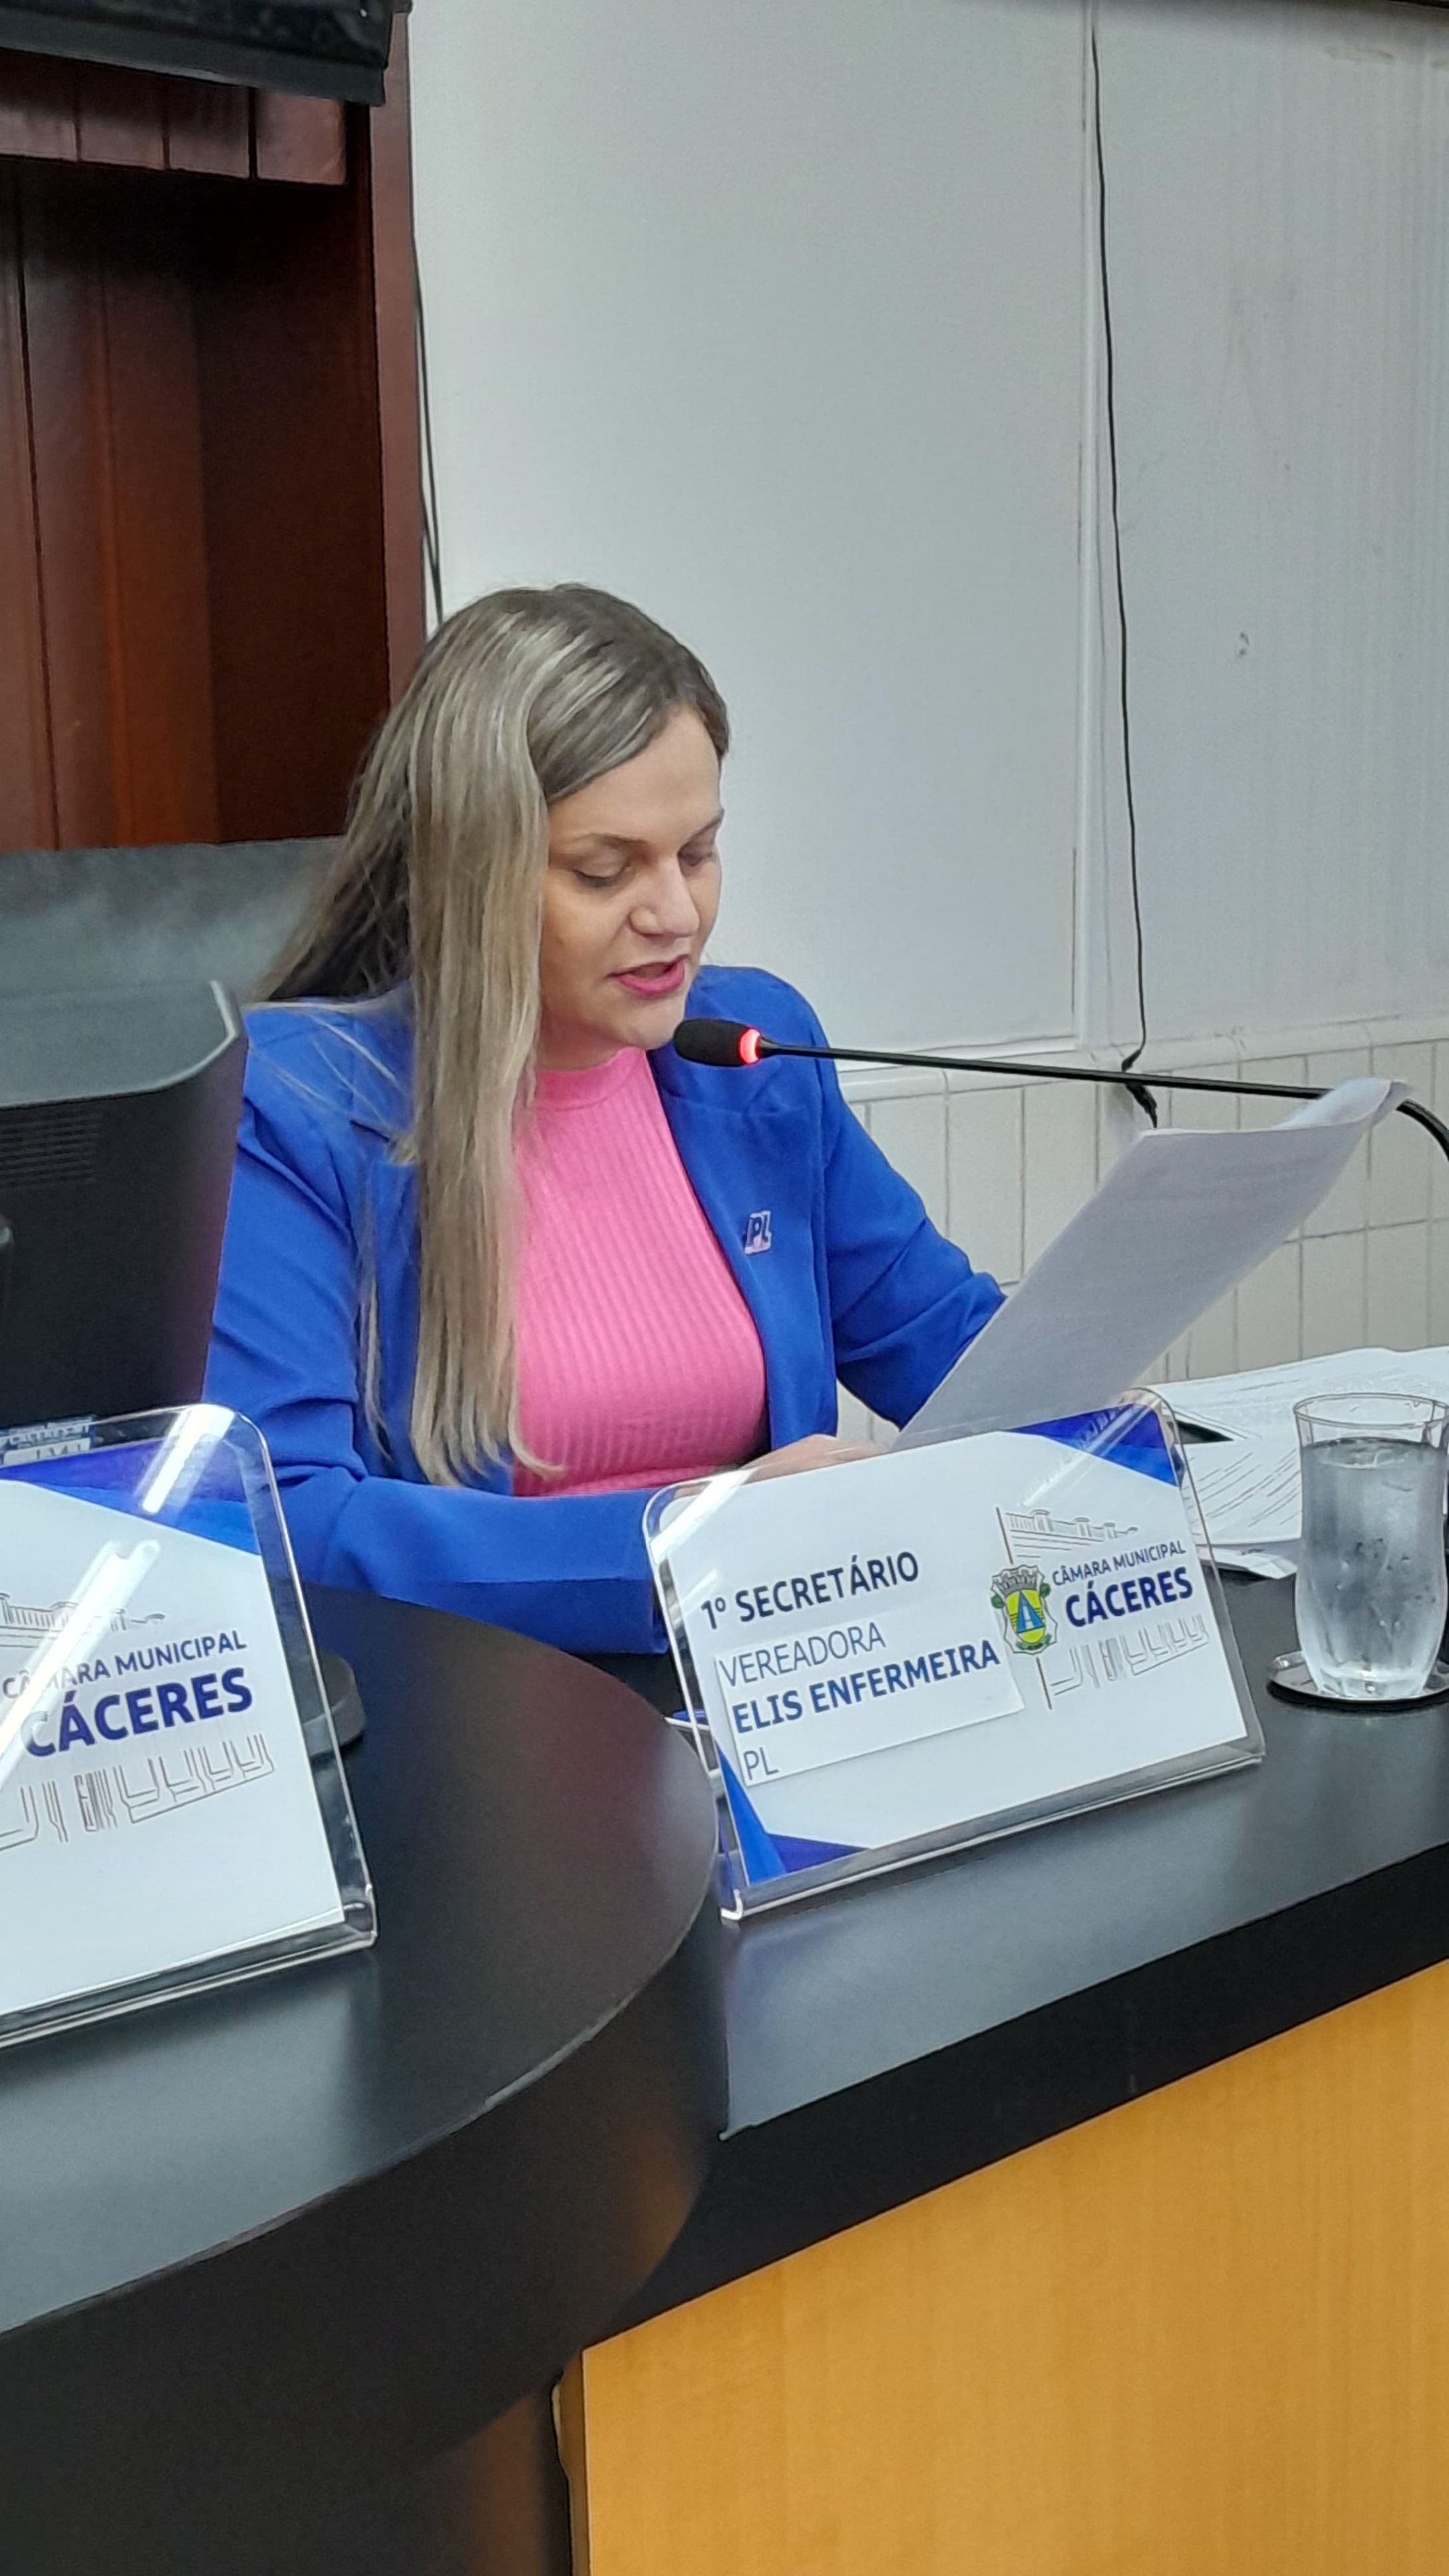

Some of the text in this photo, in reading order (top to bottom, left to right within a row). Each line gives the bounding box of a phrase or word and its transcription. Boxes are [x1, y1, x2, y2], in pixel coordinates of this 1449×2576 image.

[735, 1551, 919, 1622] SECRETÁRIO
[1052, 1539, 1186, 1585] CÂMARA MUNICIPAL
[1065, 1566, 1193, 1627] CÁCERES
[114, 1630, 247, 1675] MUNICIPAL
[719, 1622, 887, 1687] VEREADORA
[21, 1667, 253, 1757] CÁCERES
[732, 1639, 1002, 1734] ELIS ENFERMEIRA
[743, 1747, 779, 1781] PL
